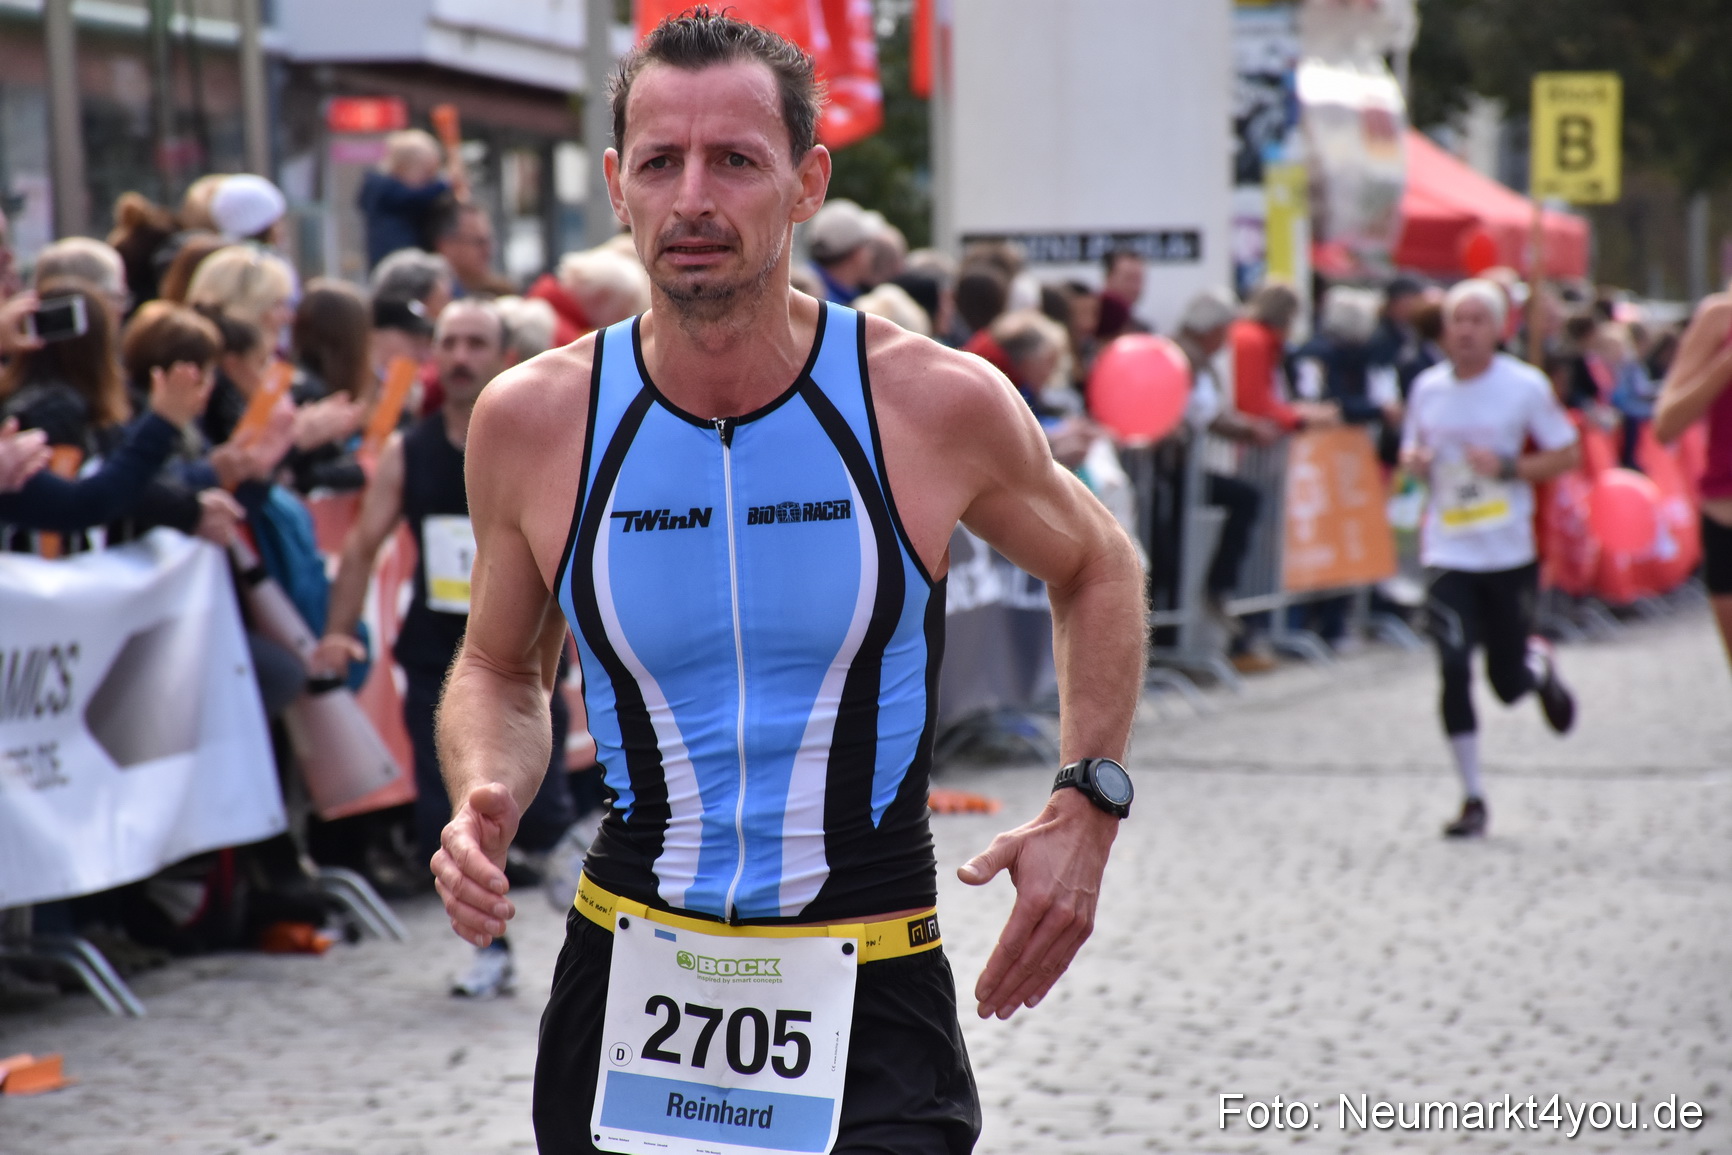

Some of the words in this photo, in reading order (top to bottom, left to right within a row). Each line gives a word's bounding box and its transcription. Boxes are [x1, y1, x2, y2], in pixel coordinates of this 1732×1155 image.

[1558, 114, 1596, 171] B
[802, 499, 851, 522] RACER
[697, 955, 782, 977] BOCK
[697, 974, 721, 983] inspired
[722, 977, 731, 985] by
[753, 977, 783, 985] concepts
[641, 995, 812, 1079] 2705
[616, 1048, 625, 1061] D
[666, 1092, 774, 1129] Reinhard
